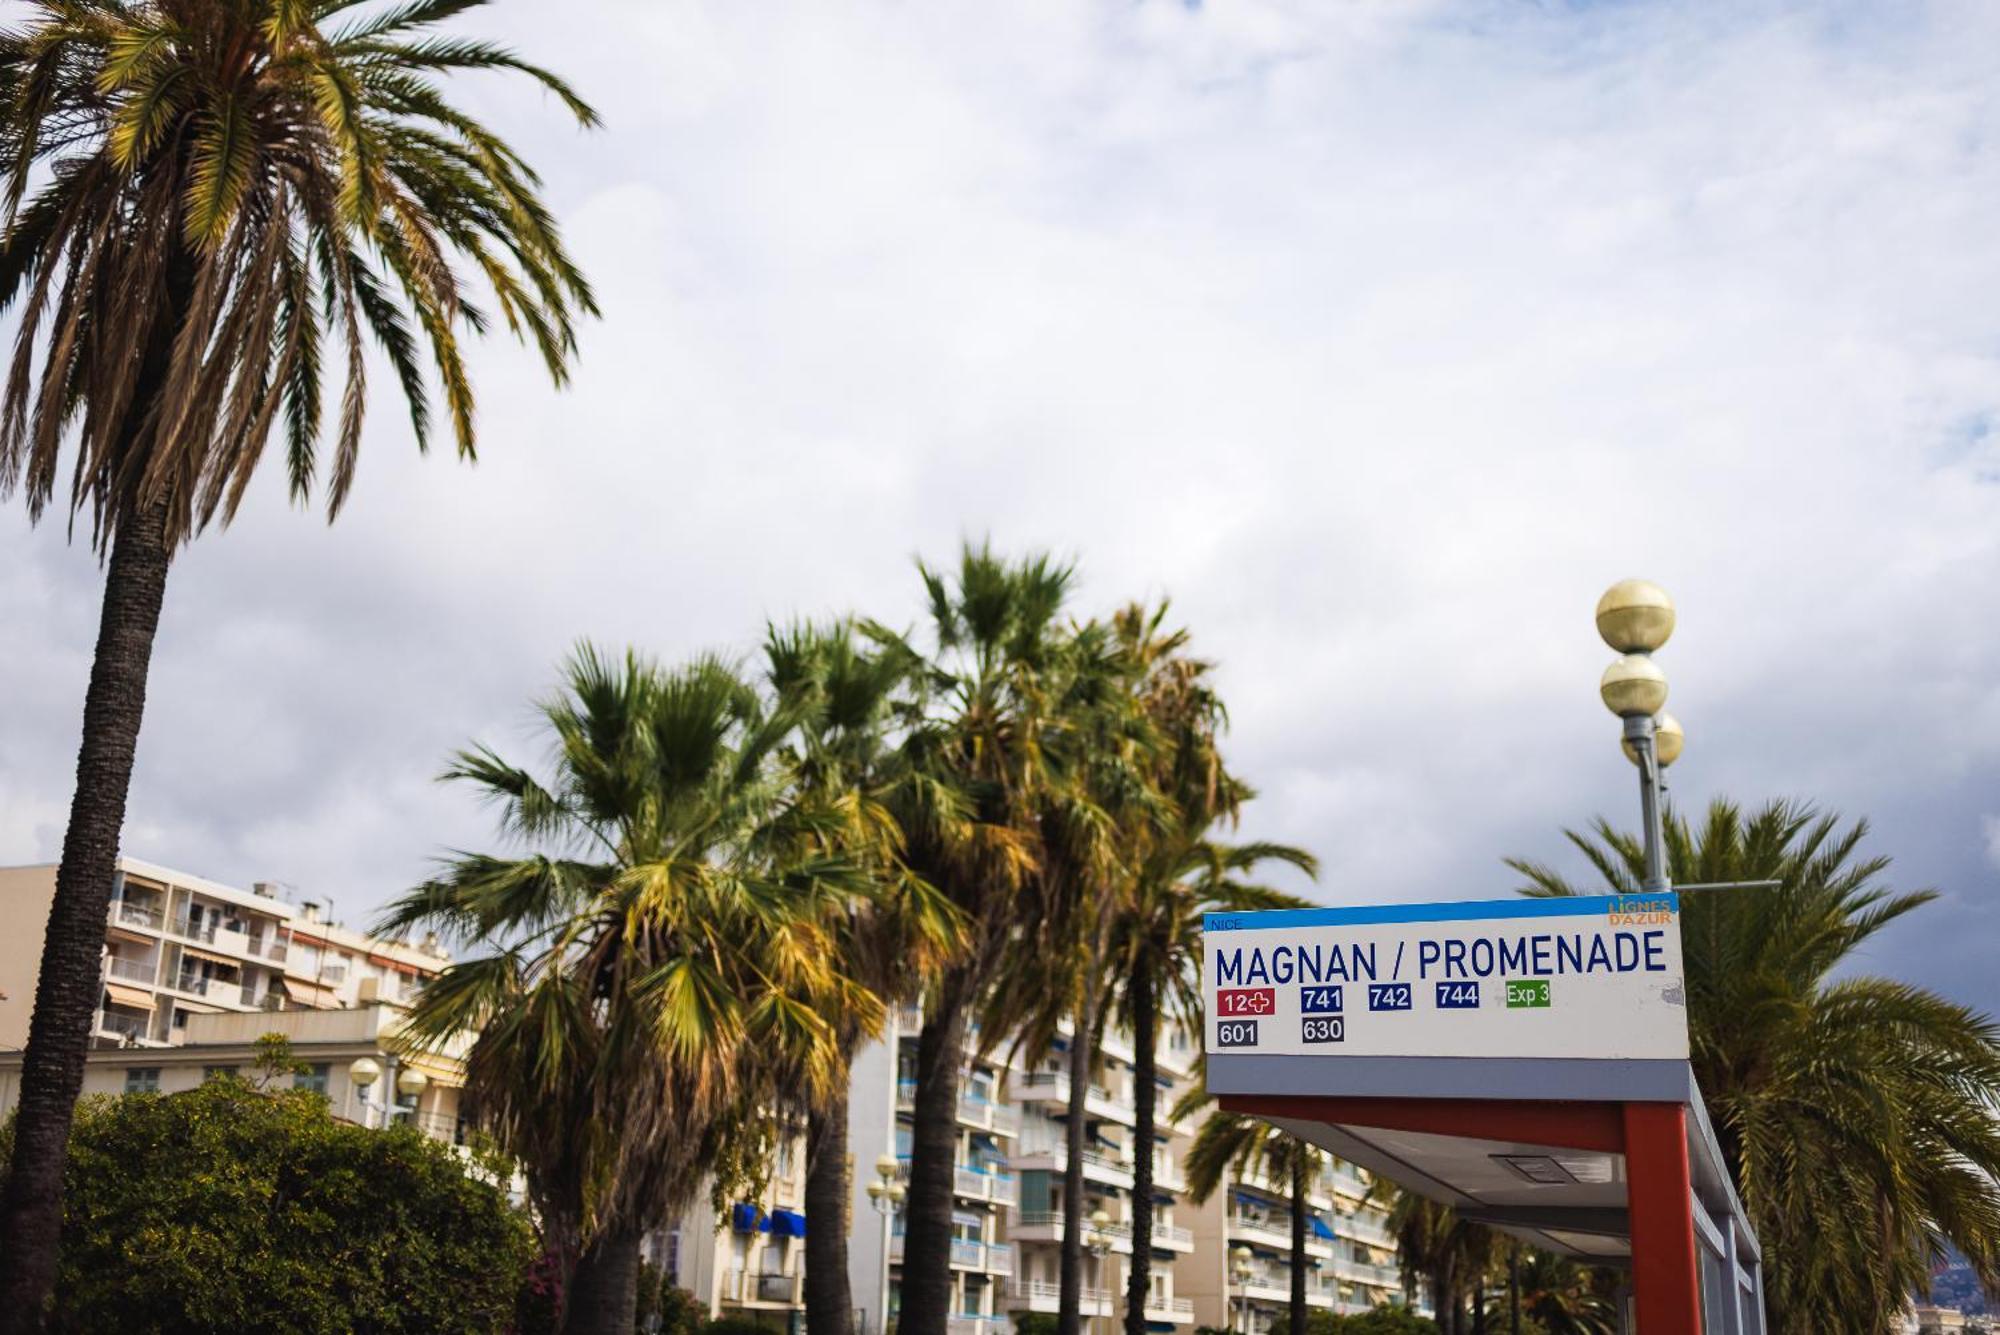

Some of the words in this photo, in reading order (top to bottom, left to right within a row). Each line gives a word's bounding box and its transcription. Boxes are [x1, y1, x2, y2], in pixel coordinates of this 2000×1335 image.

[1211, 919, 1243, 930] NICE
[1217, 942, 1376, 986] MAGNAN
[1393, 941, 1404, 980] /
[1419, 930, 1666, 979] PROMENADE
[1303, 989, 1341, 1009] 741
[1370, 988, 1409, 1007] 742
[1438, 985, 1477, 1004] 744
[1507, 985, 1536, 1006] Exp
[1540, 984, 1549, 1001] 3
[1220, 1024, 1254, 1043] 601
[1303, 1020, 1342, 1039] 630
